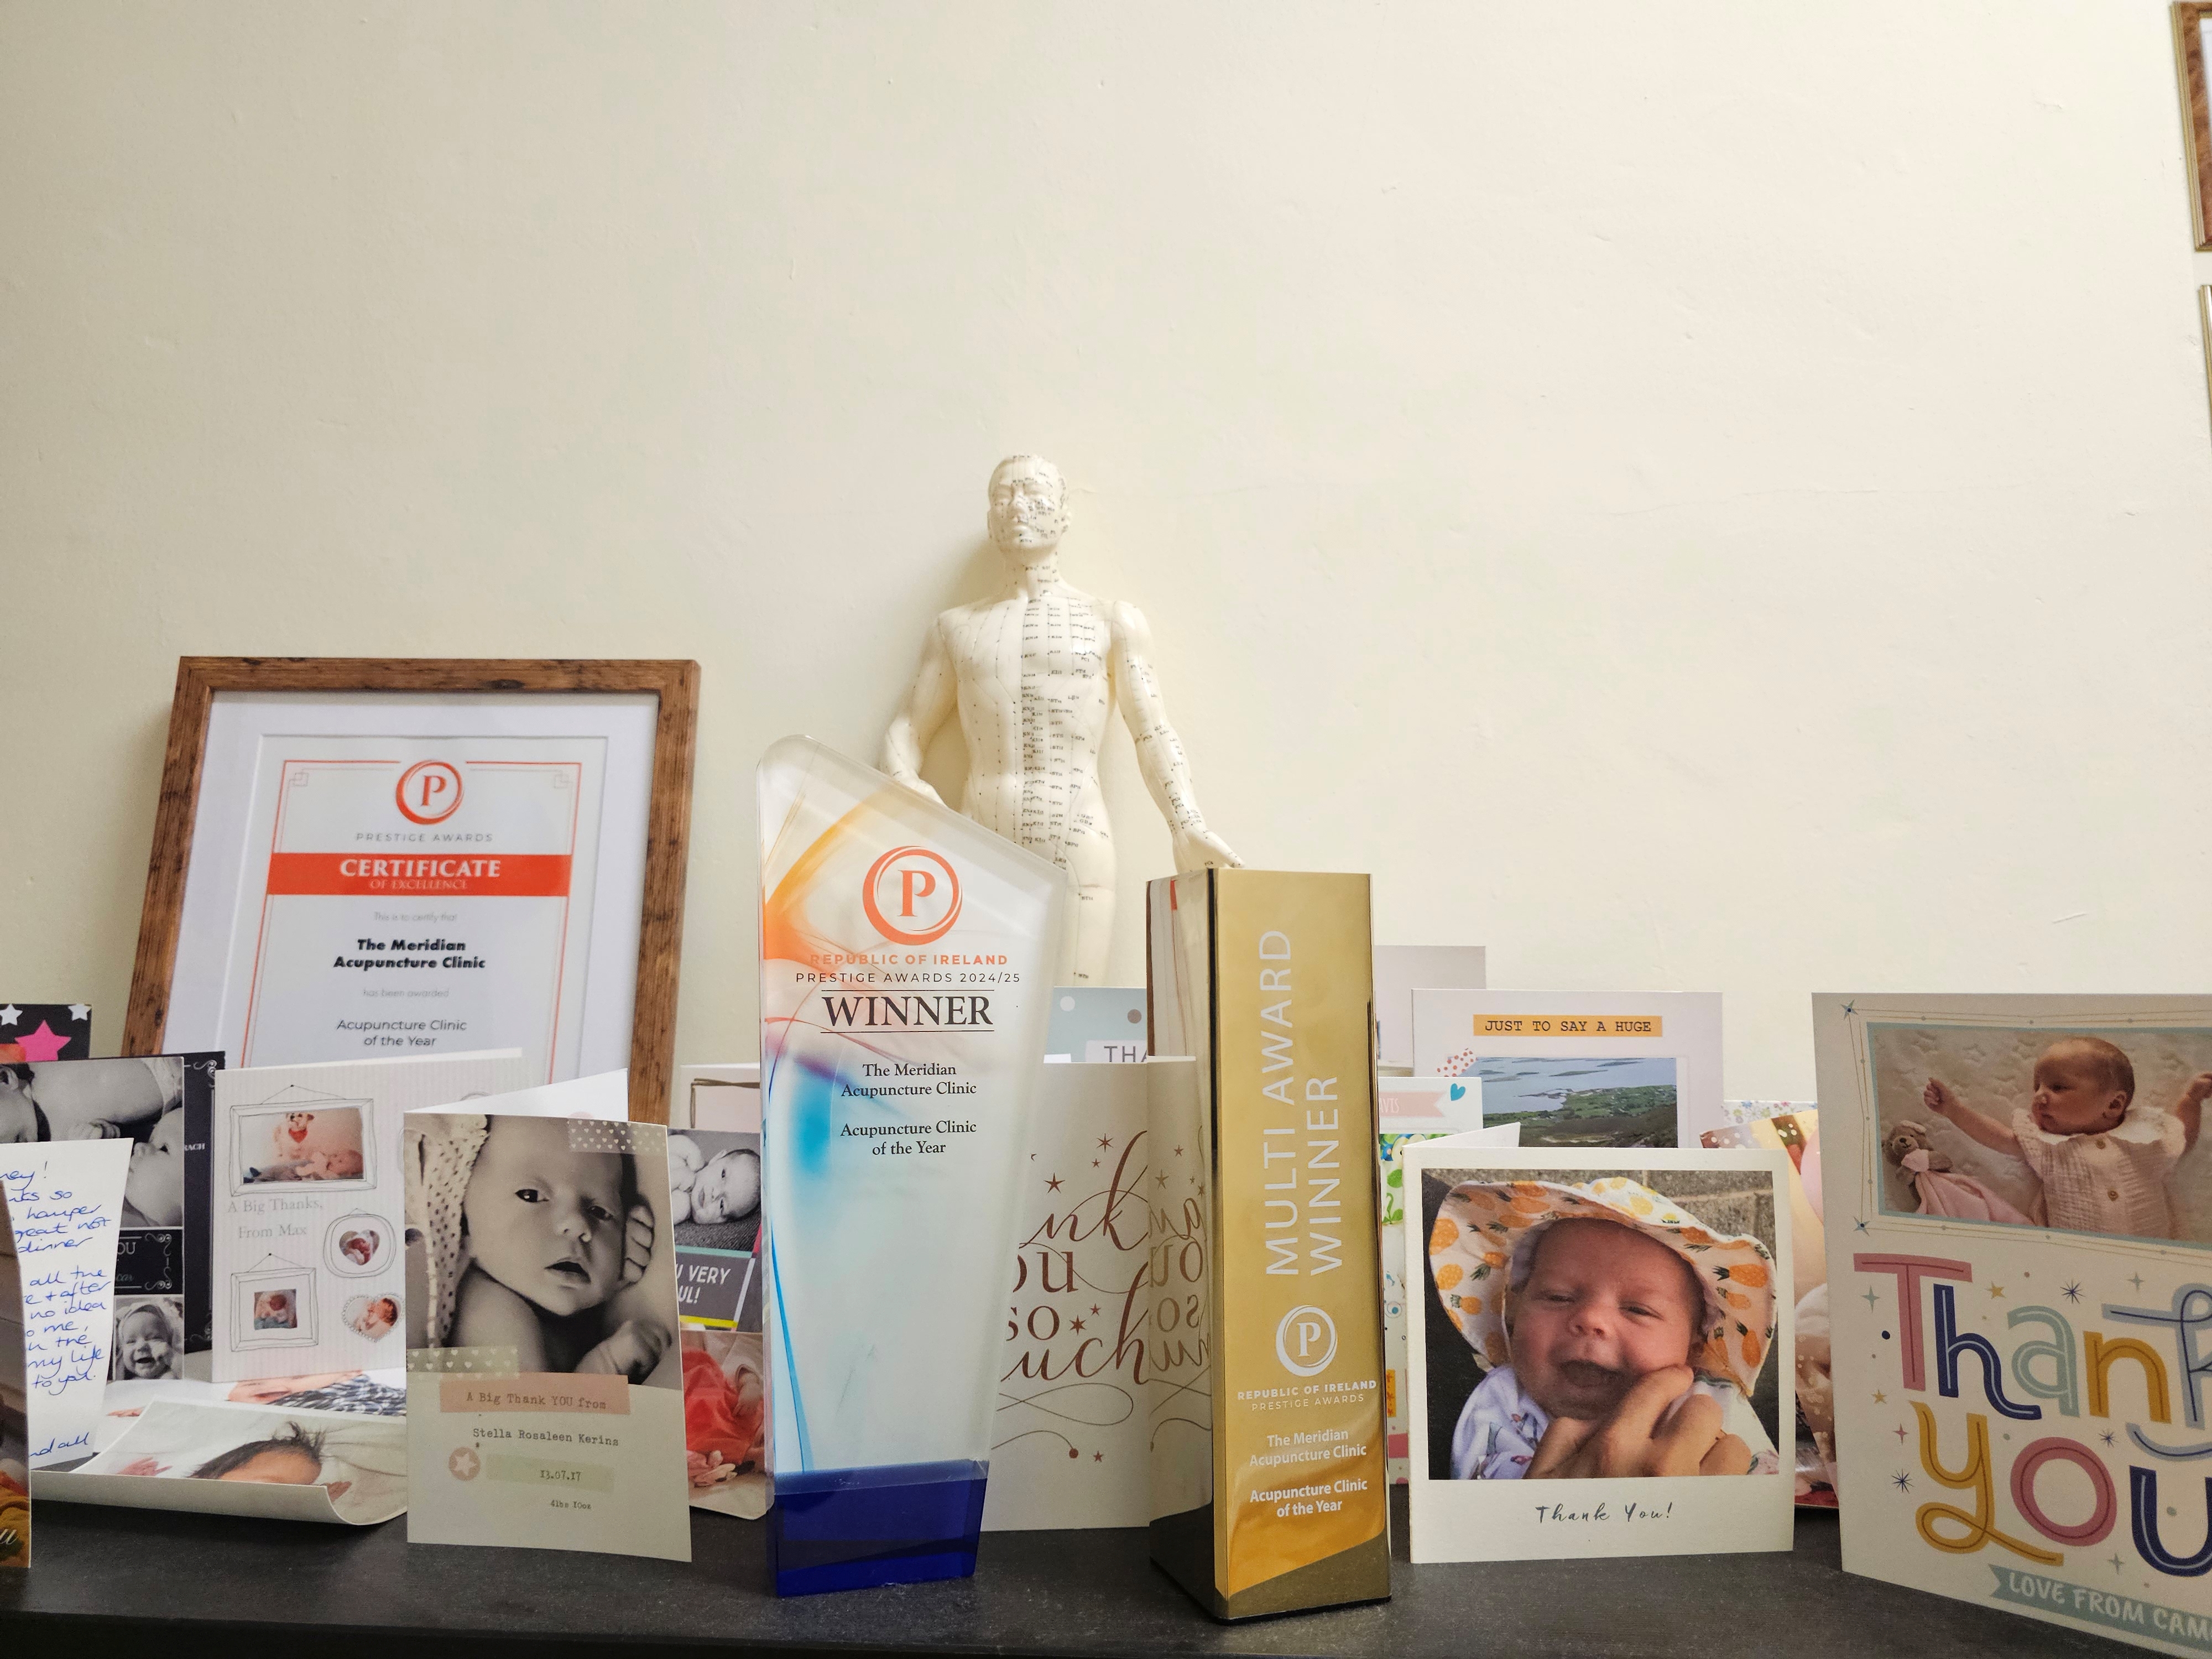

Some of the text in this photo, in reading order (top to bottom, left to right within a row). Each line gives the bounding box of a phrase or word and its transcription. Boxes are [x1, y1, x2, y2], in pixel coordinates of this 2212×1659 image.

[421, 775, 447, 806] P
[356, 833, 494, 842] PRESTIGE AWARDS
[340, 859, 501, 878] CERTIFICATE
[369, 879, 468, 890] OF EXCELLENCE
[899, 870, 936, 917] P
[374, 912, 457, 923] This is to certify that
[358, 939, 466, 951] The Meridian
[333, 956, 486, 971] Acupuncture Clinic
[810, 954, 1008, 965] REPUBLIC OF IRELAND
[796, 972, 1021, 983] PRESTIGE AWARDS 2024/25
[363, 988, 450, 998] has been awarded
[821, 995, 994, 1026] WINNER
[337, 1019, 467, 1032] Acupuncture Clinic
[1485, 1020, 1651, 1032] JUST TO SAY A HUGE
[364, 1035, 436, 1046] of the Year
[862, 1063, 957, 1077] The Meridian
[841, 1082, 977, 1098] Acupuncture Clinic
[1259, 930, 1299, 1275] MULTI AWARD
[840, 1120, 977, 1138] Acupuncture Clinic
[872, 1142, 946, 1156] of the Year
[1306, 1076, 1343, 1276] WINNER
[227, 1197, 322, 1215] A Big Thanks,
[238, 1224, 307, 1239] From Max
[689, 1265, 731, 1285] VERY
[1297, 1322, 1321, 1357] P
[1238, 1380, 1376, 1400] REPUBLIC OF IRELAND
[467, 1392, 606, 1409] A Big Thank YOU from
[1252, 1394, 1364, 1411] PRESTIGE AWARDS
[473, 1428, 619, 1446] Stella Rosaleen Kerins
[1267, 1429, 1348, 1447] The Meridian
[1250, 1444, 1366, 1468] Acupuncture Clinic
[540, 1470, 582, 1482] 13.07.17
[1250, 1479, 1368, 1503] Acupuncture Clinic
[1277, 1499, 1342, 1518] of the Year
[1535, 1502, 1674, 1523] Thank You!
[2009, 1572, 2065, 1604] LOVE
[2073, 1589, 2145, 1624] FROM
